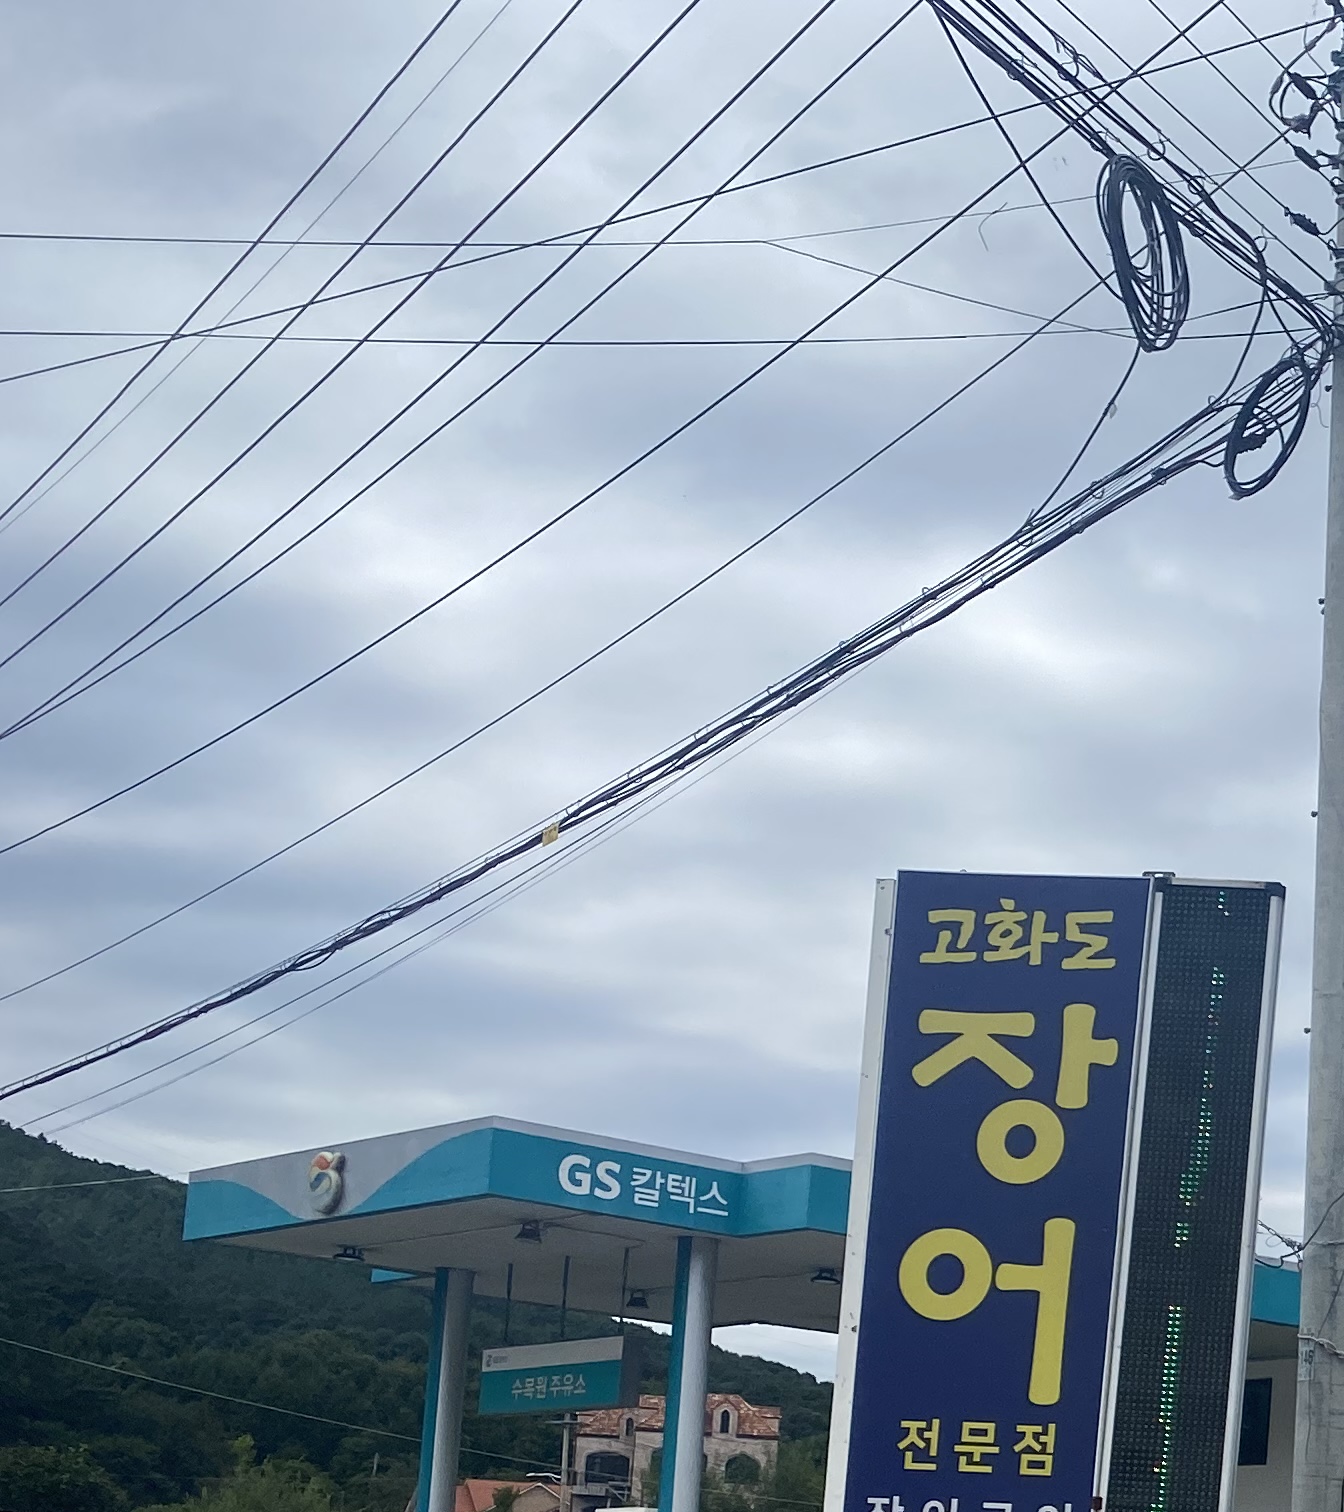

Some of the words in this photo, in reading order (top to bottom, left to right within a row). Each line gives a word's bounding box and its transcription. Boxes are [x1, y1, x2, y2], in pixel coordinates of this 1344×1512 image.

[918, 898, 1117, 970] 고화도
[558, 1154, 621, 1200] GS
[630, 1167, 729, 1217] 칼텍스
[898, 1003, 1120, 1406] 장어
[897, 1418, 1058, 1477] 전문점
